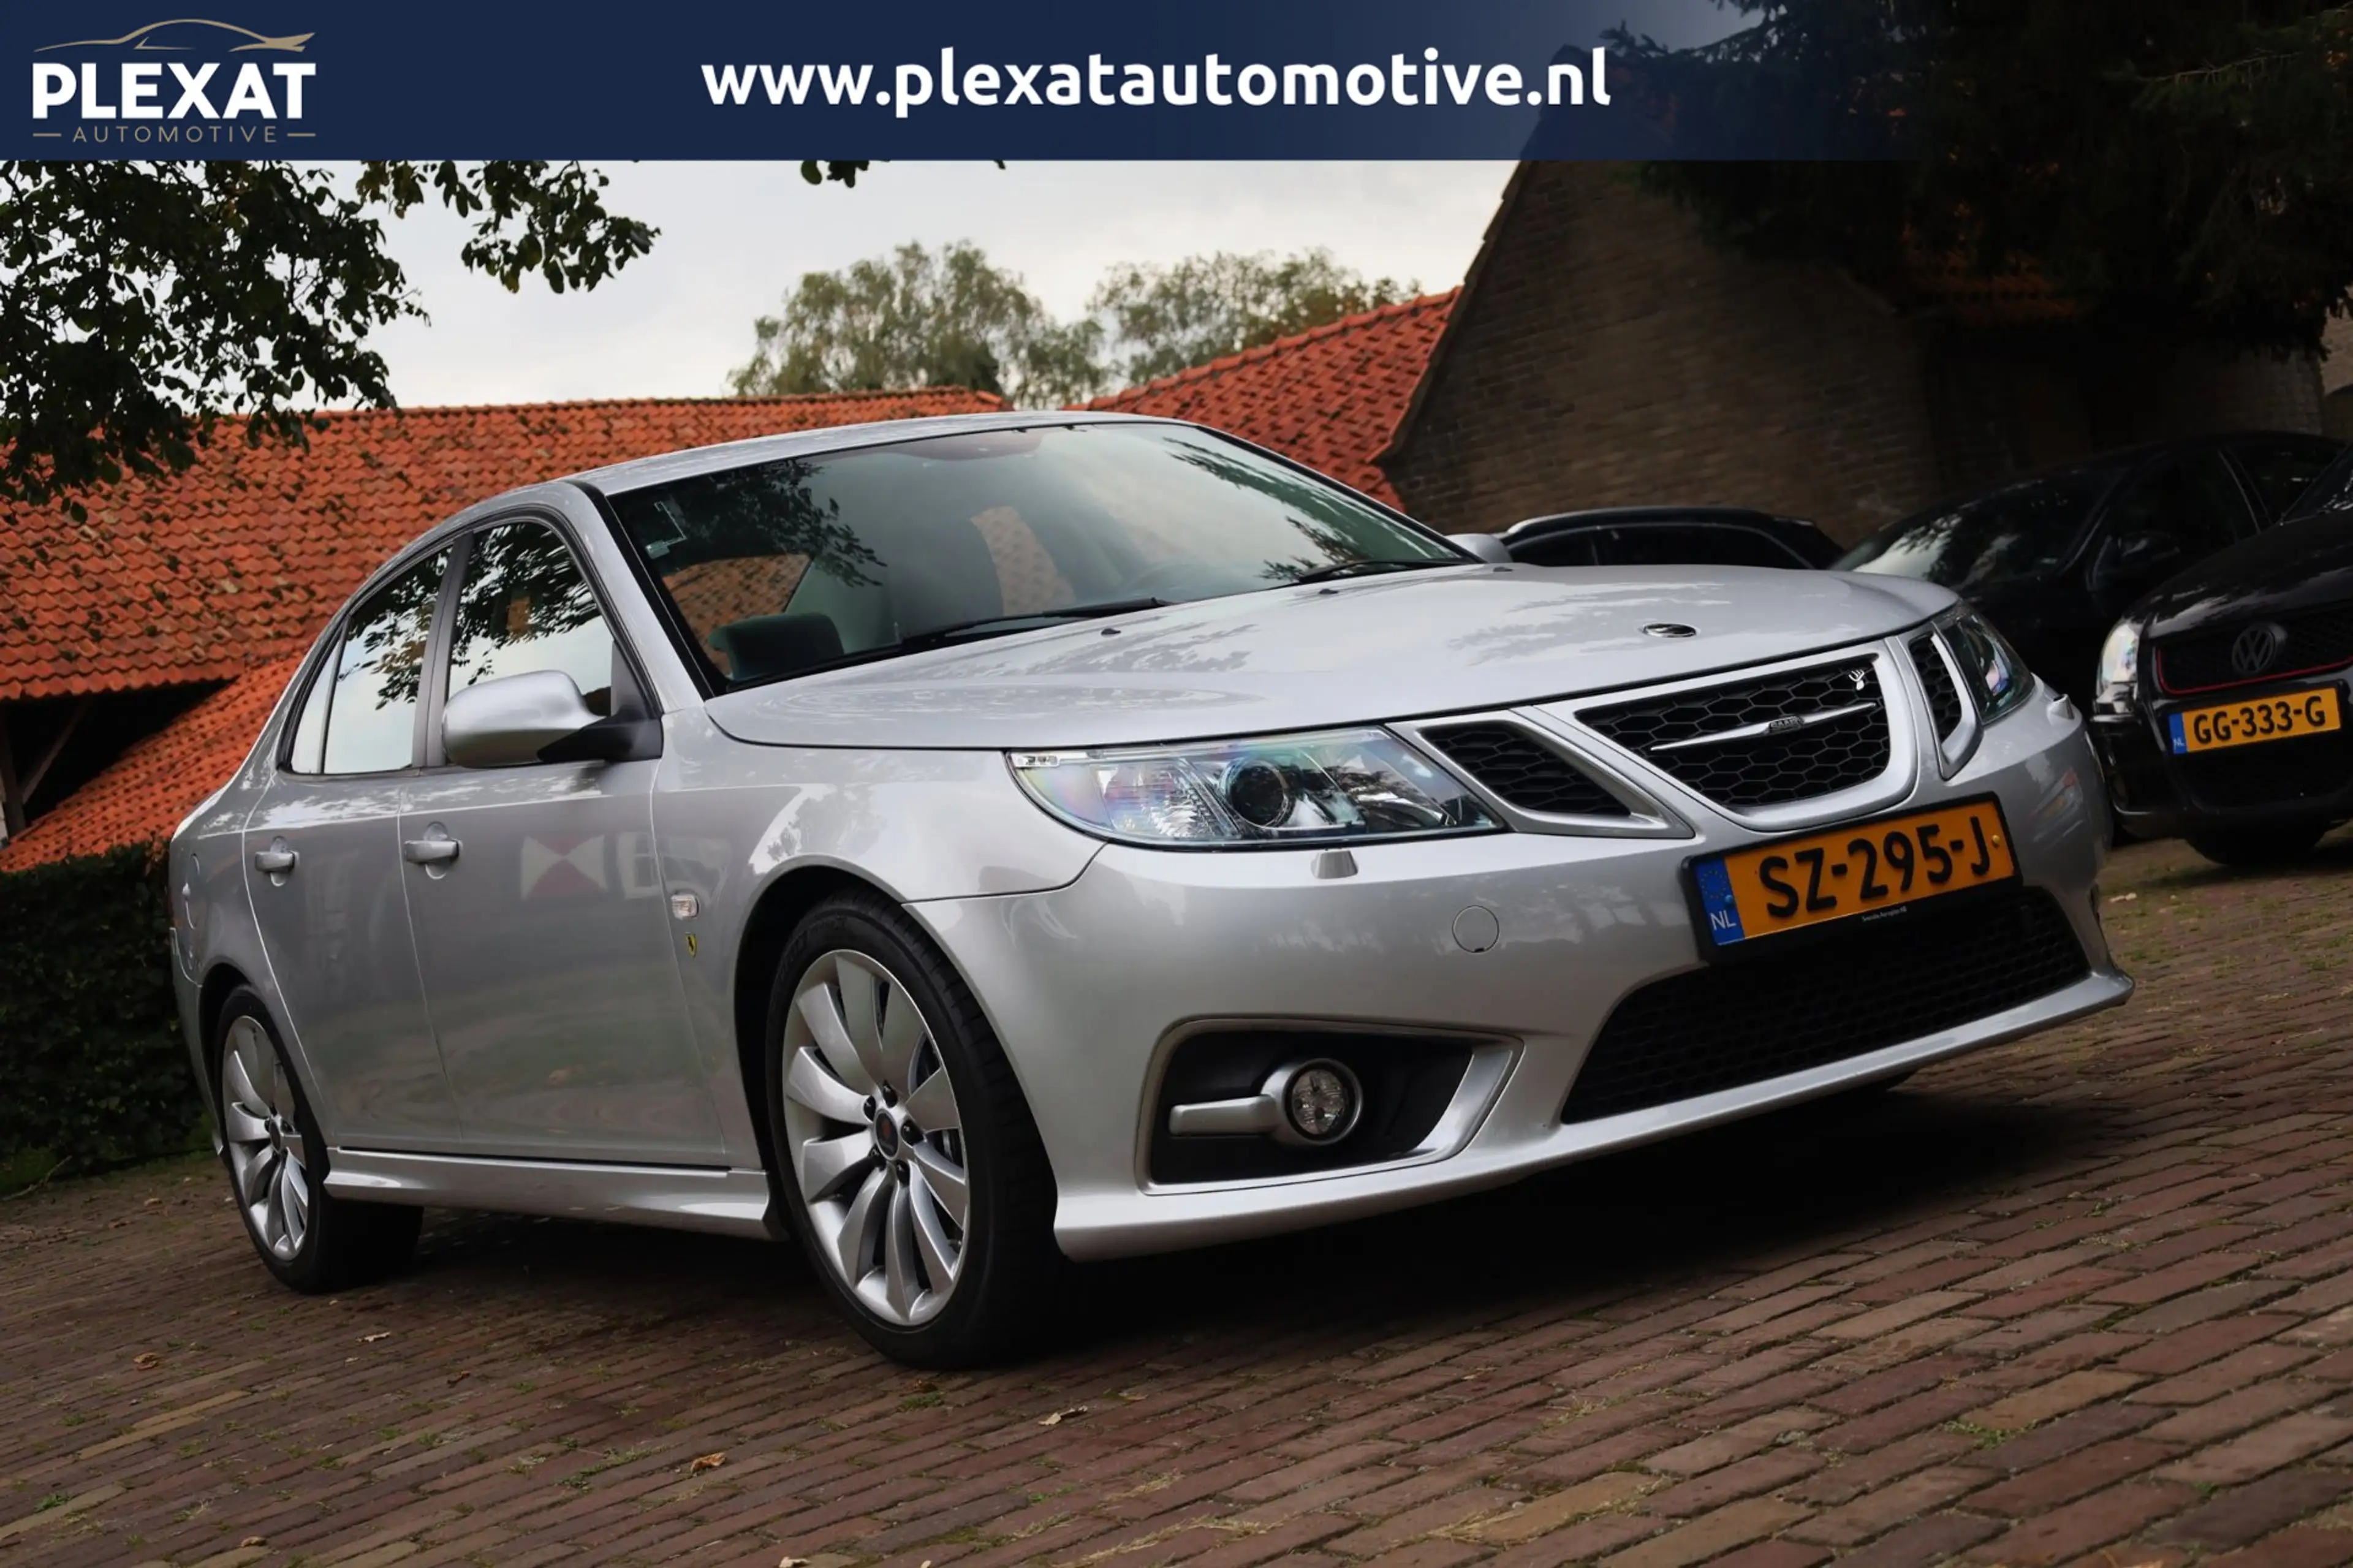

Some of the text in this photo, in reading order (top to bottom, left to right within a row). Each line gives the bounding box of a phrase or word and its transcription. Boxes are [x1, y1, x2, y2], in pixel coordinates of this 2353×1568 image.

[2193, 695, 2326, 744] GG-333-G
[2173, 738, 2185, 746] NL
[1759, 815, 1990, 918] SZ-295-J
[1710, 910, 1737, 931] NL
